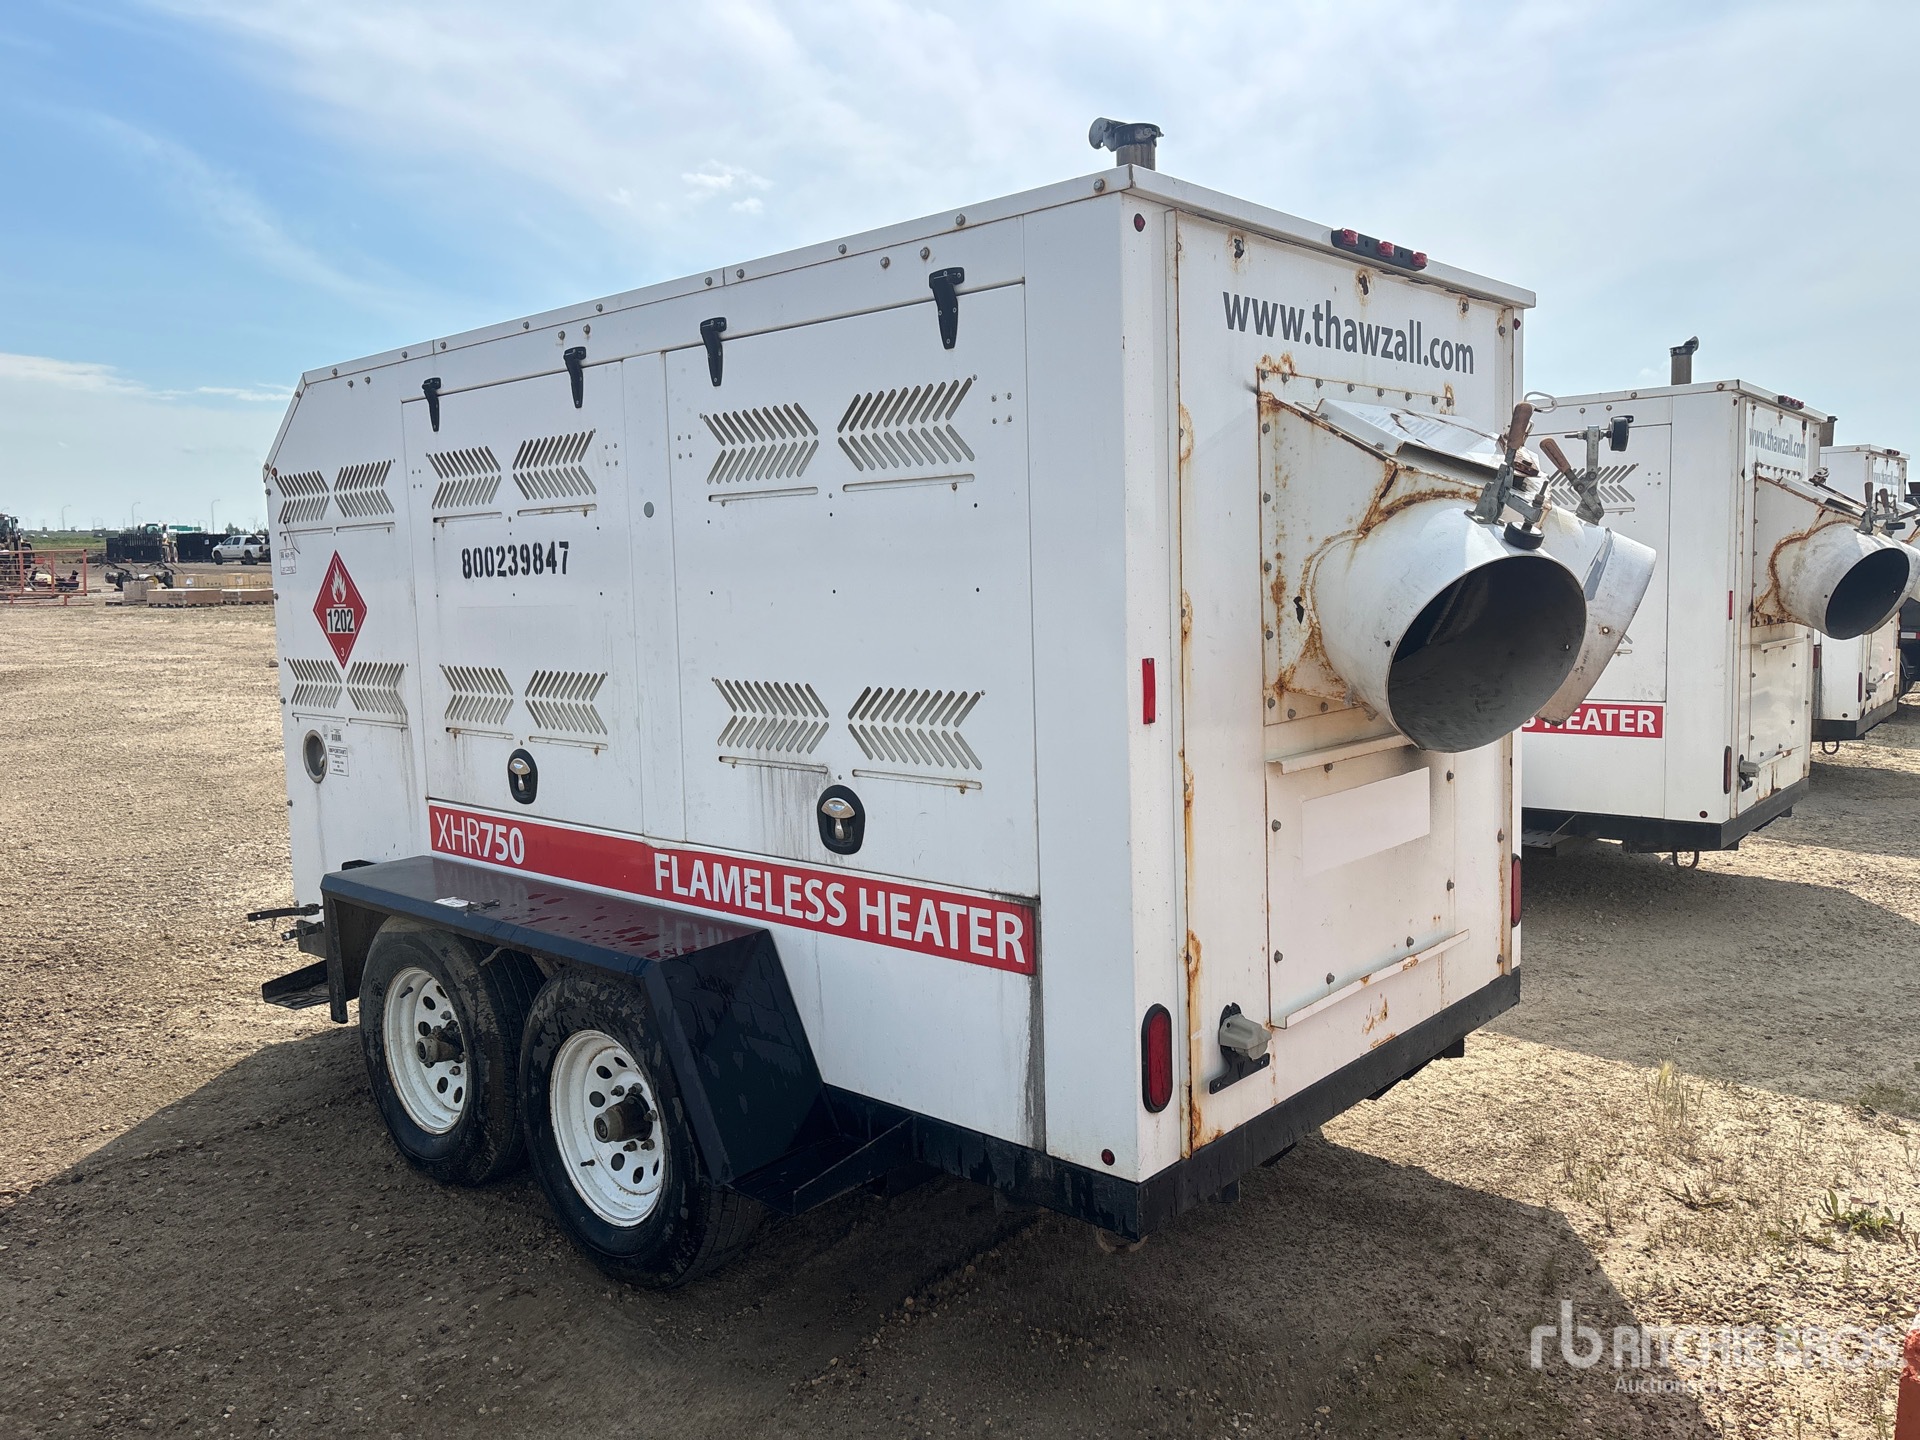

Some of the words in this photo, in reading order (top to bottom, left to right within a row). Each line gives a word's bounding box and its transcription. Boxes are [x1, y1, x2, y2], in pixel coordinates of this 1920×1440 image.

[1222, 291, 1474, 374] www.thawzall.com
[461, 541, 569, 579] 800239847
[327, 609, 354, 633] 1202
[340, 647, 345, 657] 3
[435, 811, 525, 865] XHR750
[654, 853, 847, 927] FLAMELESS
[859, 888, 1026, 964] HEATER
